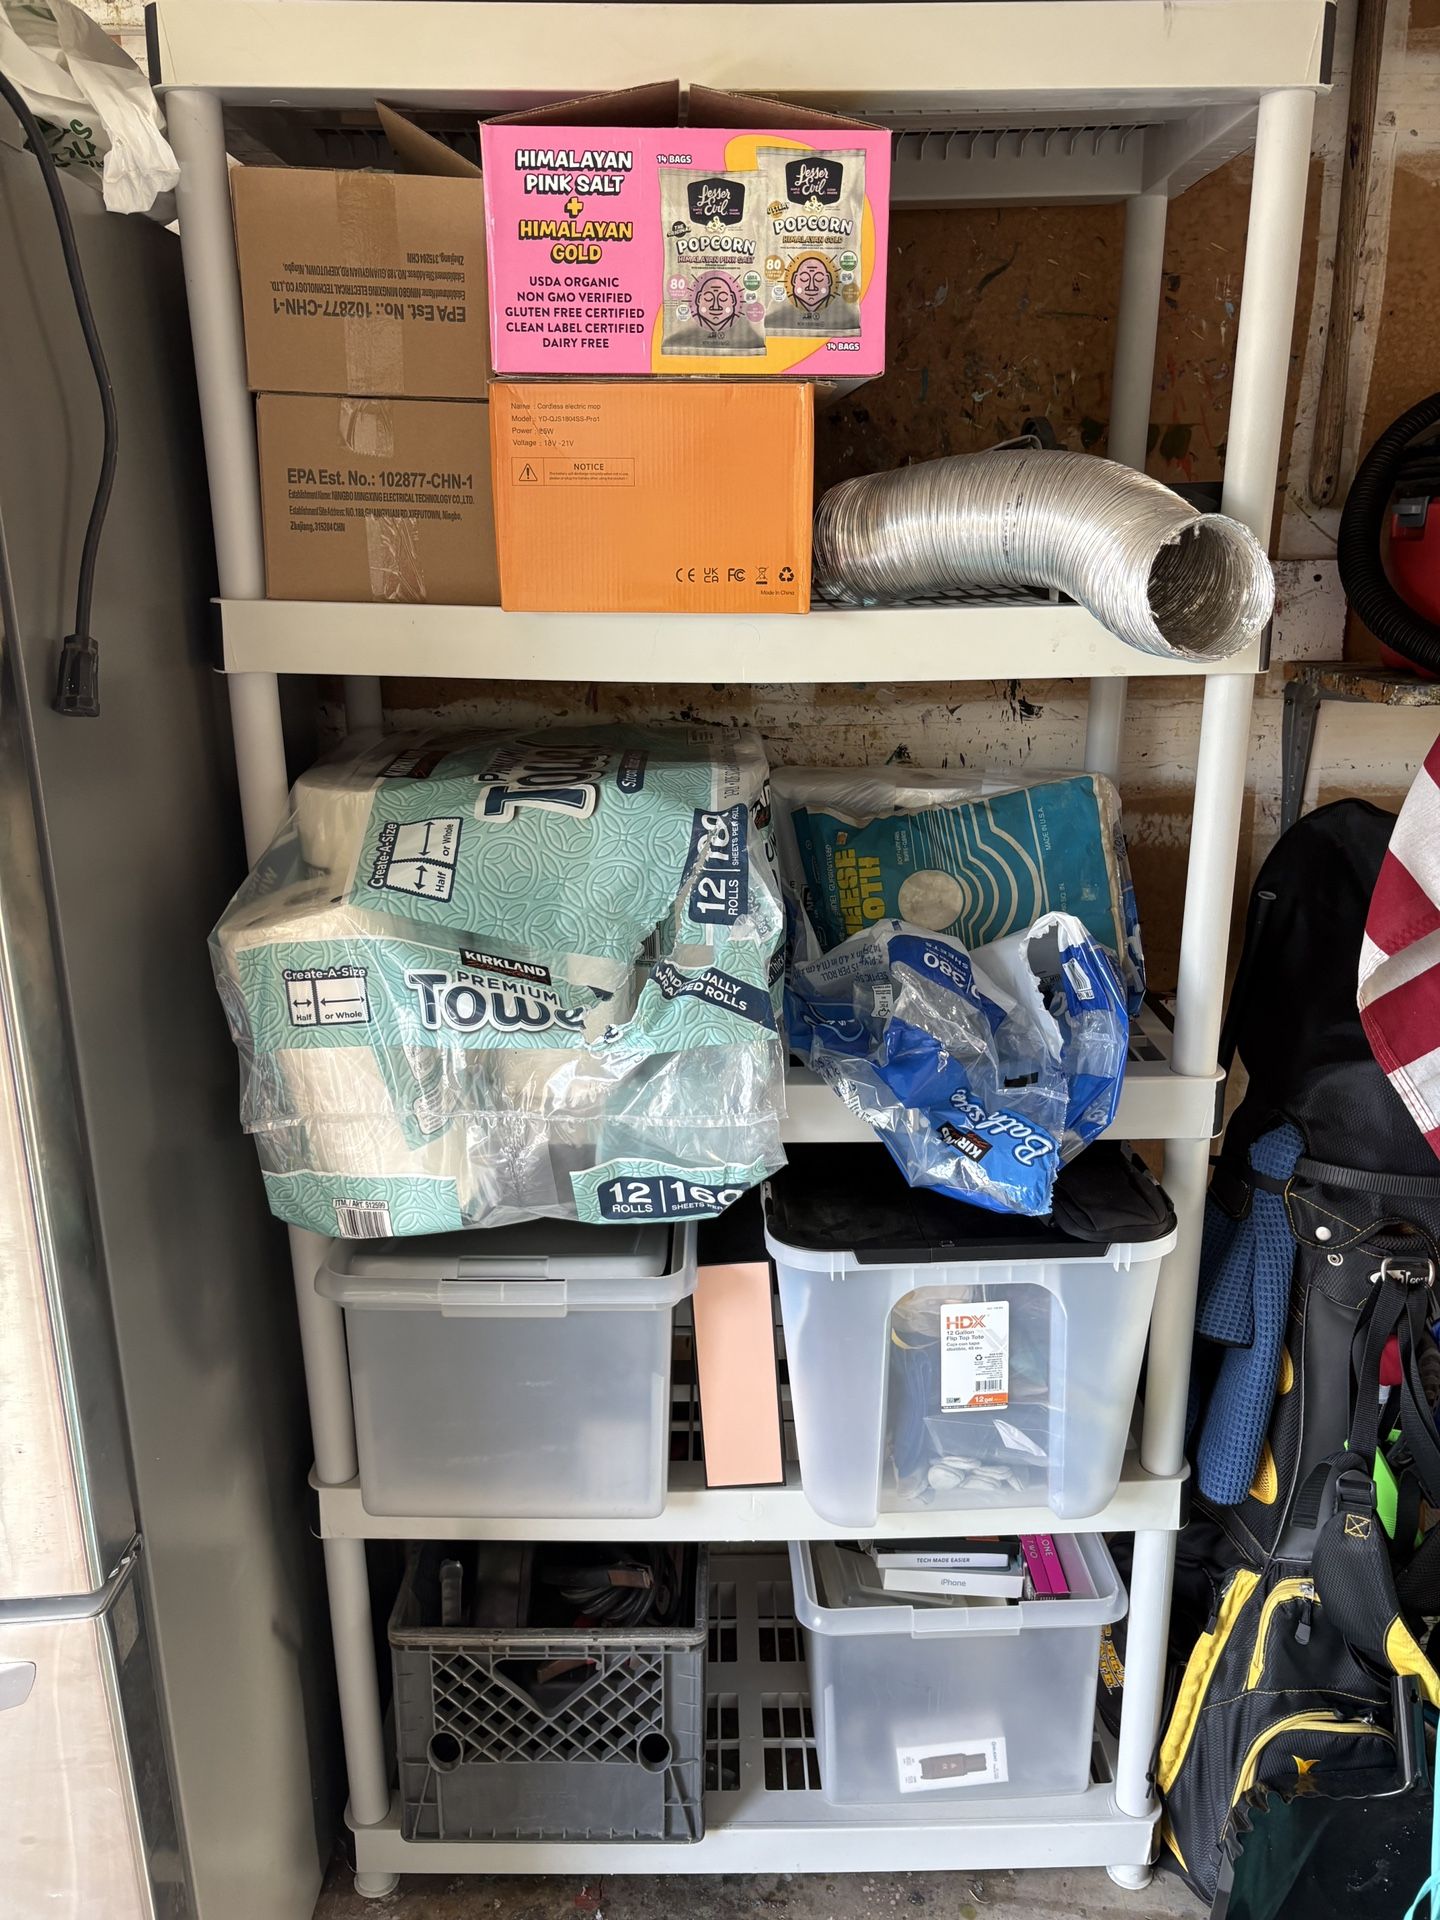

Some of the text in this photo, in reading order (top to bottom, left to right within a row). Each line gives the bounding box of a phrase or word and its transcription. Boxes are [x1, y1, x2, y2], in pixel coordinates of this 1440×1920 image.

[515, 149, 633, 171] HIMALAYAN
[657, 154, 692, 164] 14 BAGS
[524, 173, 624, 195] PINK SALT
[794, 164, 829, 186] Lesser
[802, 177, 826, 195] Evil
[697, 184, 731, 207] Lesser
[704, 198, 728, 215] Evil
[519, 219, 633, 241] HIMALAYAN
[773, 215, 853, 235] POPCORN
[676, 236, 756, 255] POPCORN
[782, 235, 843, 244] HIMALAYAN GOLD
[551, 244, 602, 264] GOLD
[678, 256, 755, 264] HIMALAYAN PINK SALT
[766, 259, 781, 269] 80
[295, 282, 334, 294] TECHNOLOGY
[335, 284, 367, 296] ELECTRICAL
[529, 276, 620, 288] USDA ORGANIC
[670, 278, 685, 289] 80
[399, 287, 421, 298] NINGBO
[517, 292, 632, 303] NON GMO VERIFIED
[273, 298, 466, 322] EPA Est. No.: 102877-CHN-1
[505, 307, 645, 318] GLUTEN FREE CERTIFIED
[506, 322, 645, 333] CLEAN LABEL CERTIFIED
[543, 338, 609, 348] DAIRY FREE
[826, 342, 860, 351] 14 BAGS
[512, 439, 536, 447] Voltage
[573, 463, 604, 471] NOTICE
[288, 468, 473, 489] EPA Est. No.: 102877-CHN-1
[332, 491, 353, 501] NINGBO
[383, 492, 414, 503] ELECTRICAL
[415, 493, 452, 504] TECHNOLOGY
[1042, 832, 1051, 851] MADE
[370, 822, 398, 888] Create-A-Size
[435, 823, 454, 893] Half or Whole
[697, 876, 727, 914] 12
[858, 856, 885, 920] OTH
[728, 879, 738, 916] ROLLS
[464, 950, 547, 978] KIRKLAND
[925, 942, 969, 969] SHEETS
[283, 966, 366, 980] Create-A-Size
[821, 970, 838, 981] ROLL
[924, 952, 966, 987] 380
[457, 970, 559, 1005] PREMIUM
[408, 972, 586, 1026] Towe
[704, 986, 748, 1011] ROLLS
[335, 1010, 362, 1019] Whole
[975, 1111, 1054, 1167] Bath
[609, 1182, 652, 1203] 12
[612, 1203, 653, 1213] ROLLS
[672, 1202, 704, 1211] SHEETS
[945, 1314, 986, 1329] HDX
[1026, 1540, 1039, 1560] TWO
[1041, 1539, 1054, 1557] ONE
[940, 1579, 967, 1587] iPhone
